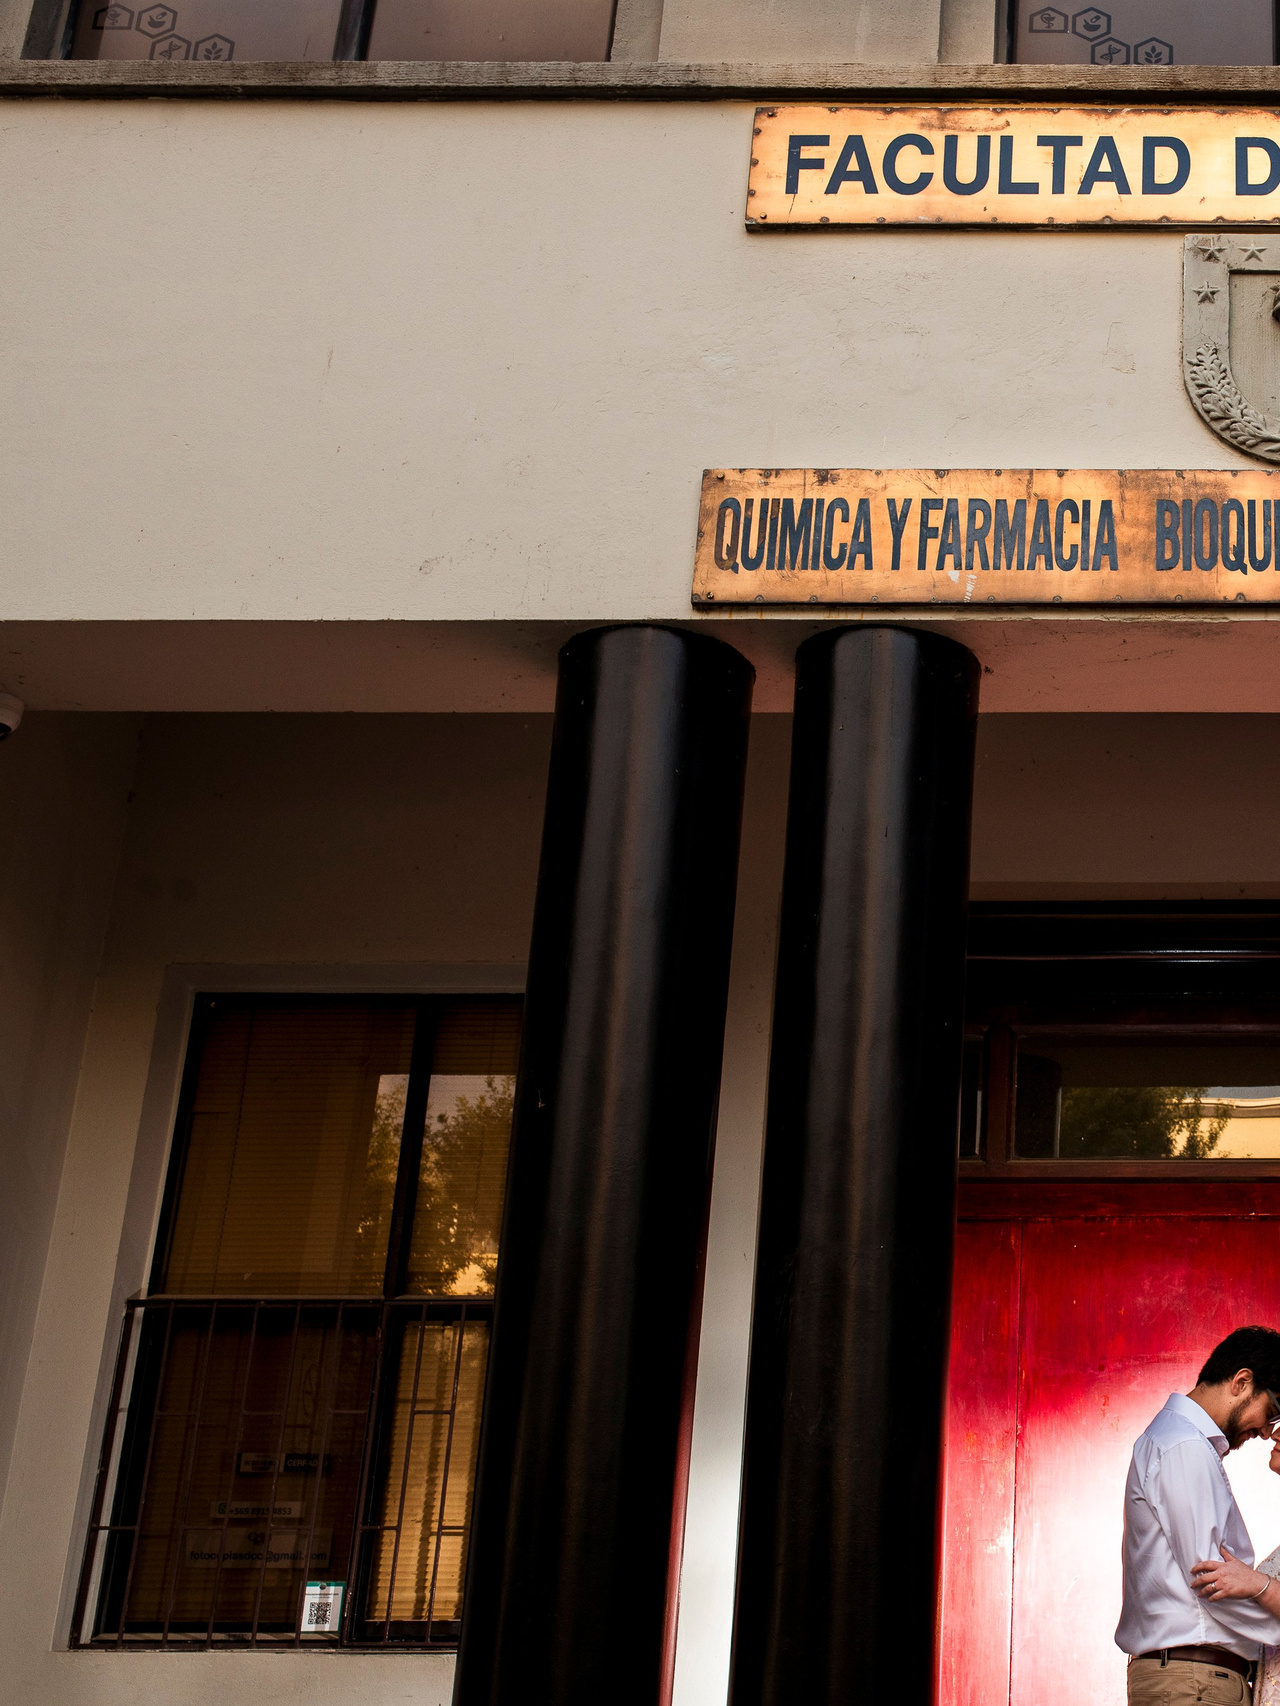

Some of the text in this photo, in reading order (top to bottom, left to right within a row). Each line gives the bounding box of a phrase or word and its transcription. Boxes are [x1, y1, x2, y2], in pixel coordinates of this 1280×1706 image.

[785, 133, 1191, 195] FACULTAD
[713, 497, 872, 575] QUIMICA
[885, 497, 911, 571] Y
[917, 498, 1119, 571] FARMACIA
